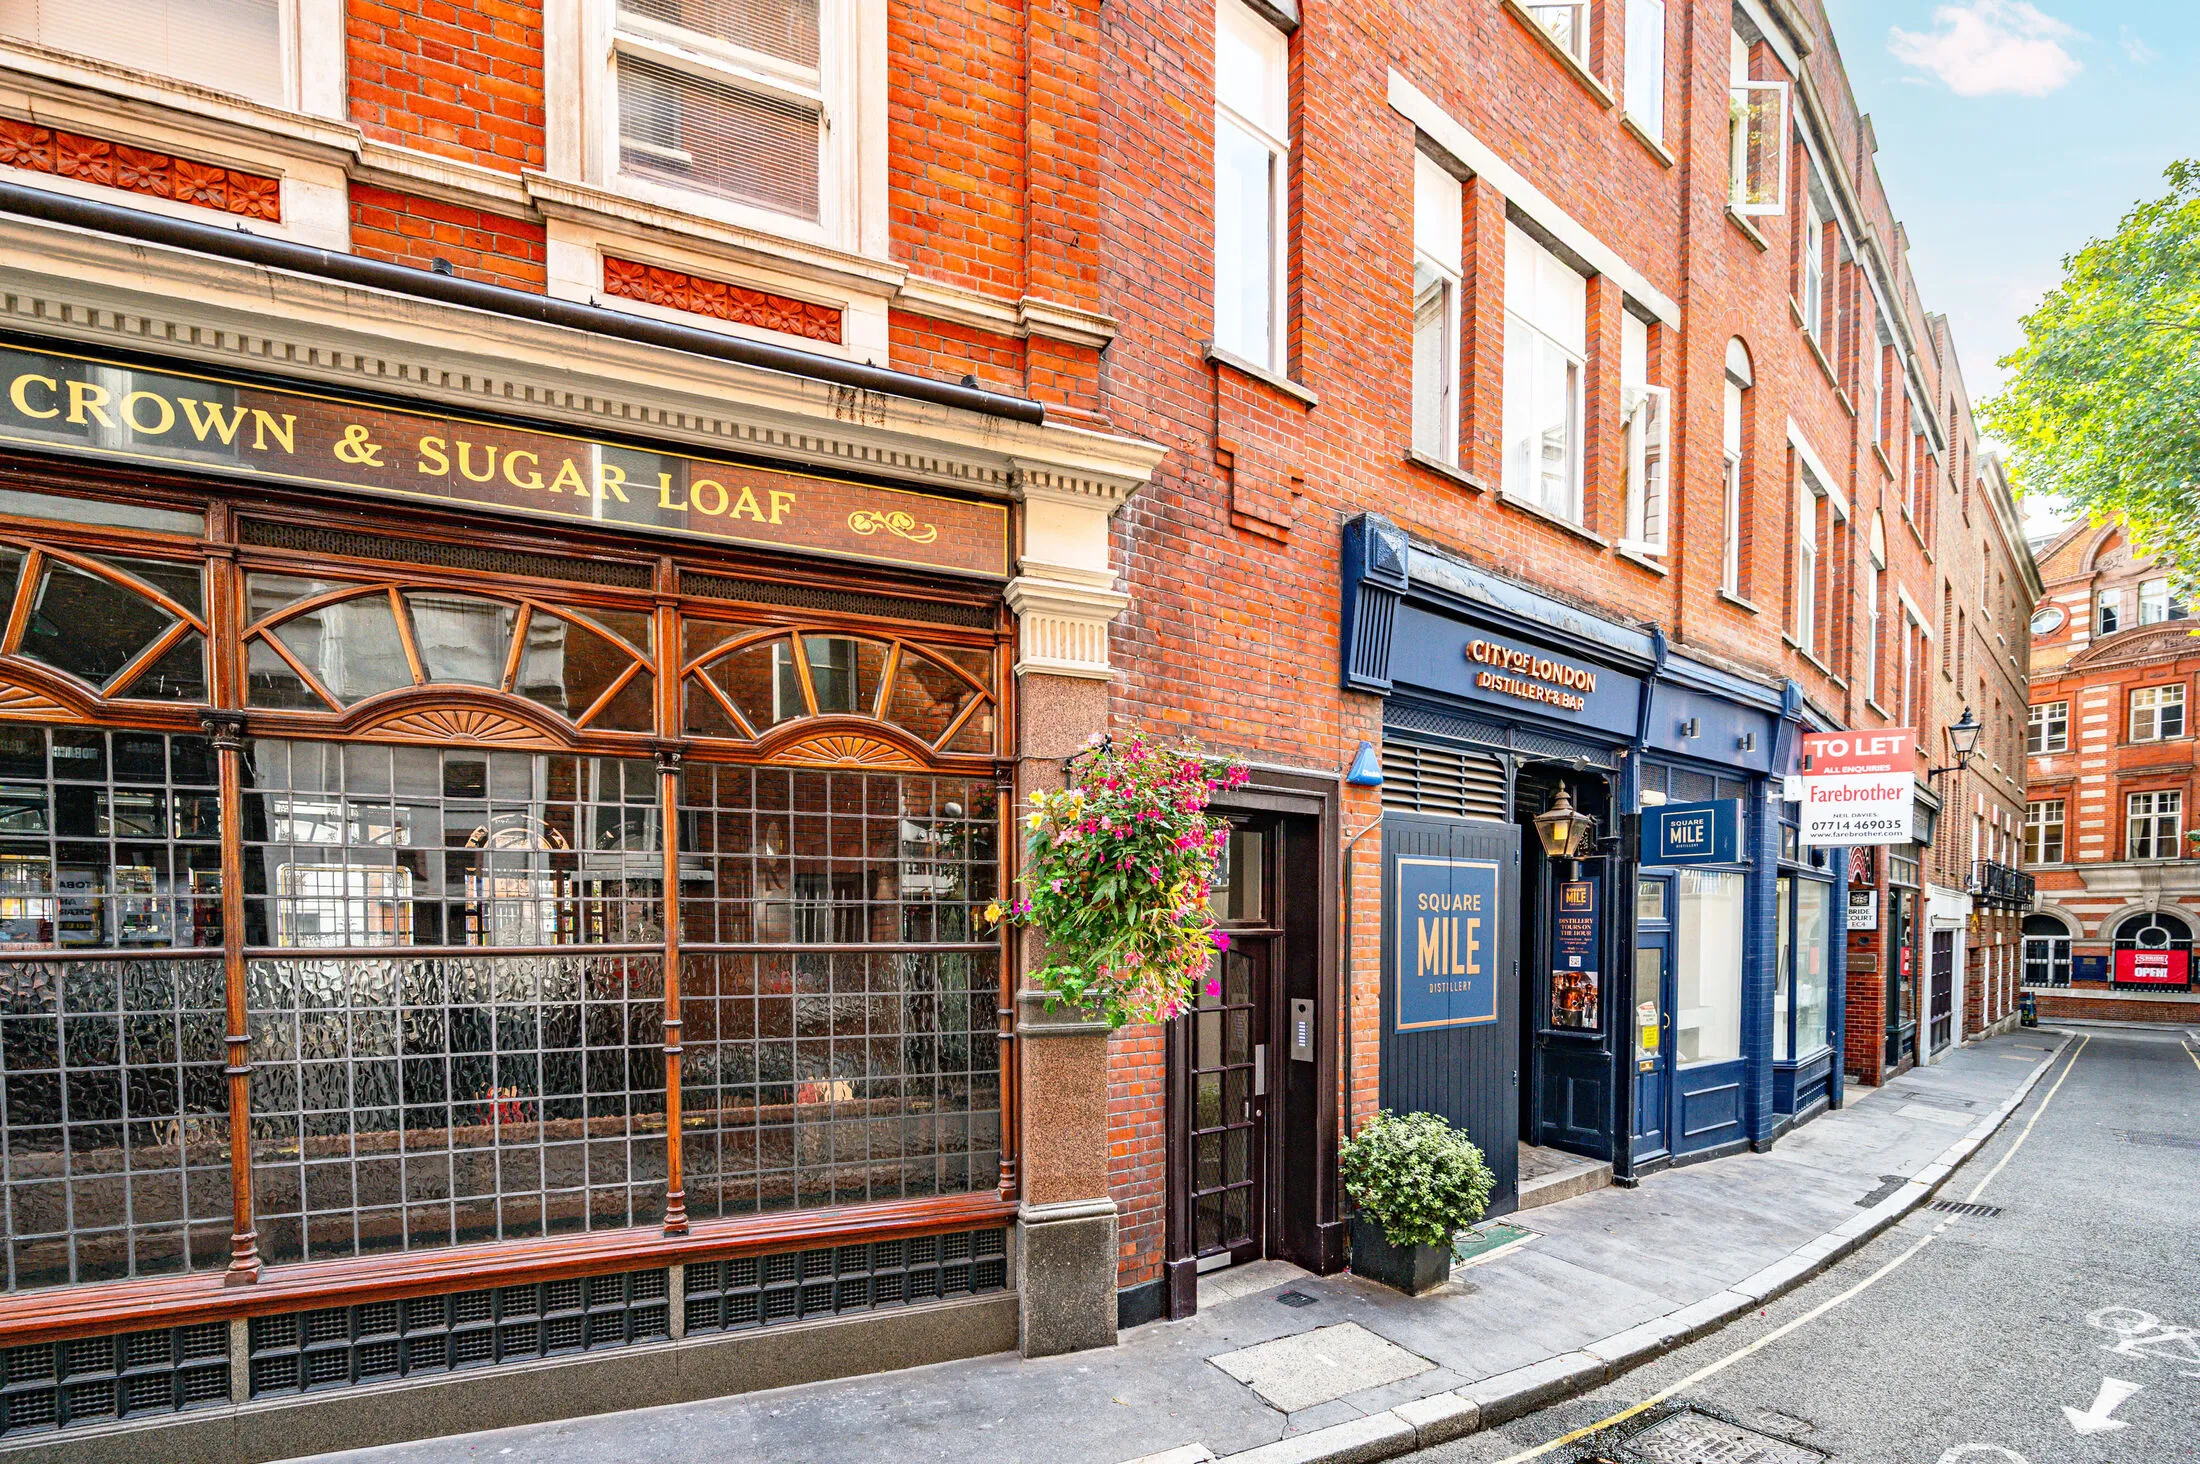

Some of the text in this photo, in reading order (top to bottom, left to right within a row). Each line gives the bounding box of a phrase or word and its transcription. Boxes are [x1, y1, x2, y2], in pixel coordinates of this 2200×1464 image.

[9, 373, 796, 526] CROWN & SUGAR LOAF
[1468, 639, 1597, 693] CITY OF LONDON
[1478, 671, 1585, 711] DISTILLERY & BAR
[1811, 735, 1906, 758] TO LET
[1823, 764, 1892, 774] ALL ENQUIRIES
[1810, 783, 1905, 803] Farebrother
[1670, 818, 1704, 827] SQUARE
[1811, 820, 1902, 831] 07714 469035
[1670, 825, 1704, 844] MILE
[1418, 893, 1481, 913] SQUARE
[1566, 891, 1587, 904] MILE
[1417, 917, 1481, 977] MILE
[1429, 981, 1472, 994] DISTILLERY
